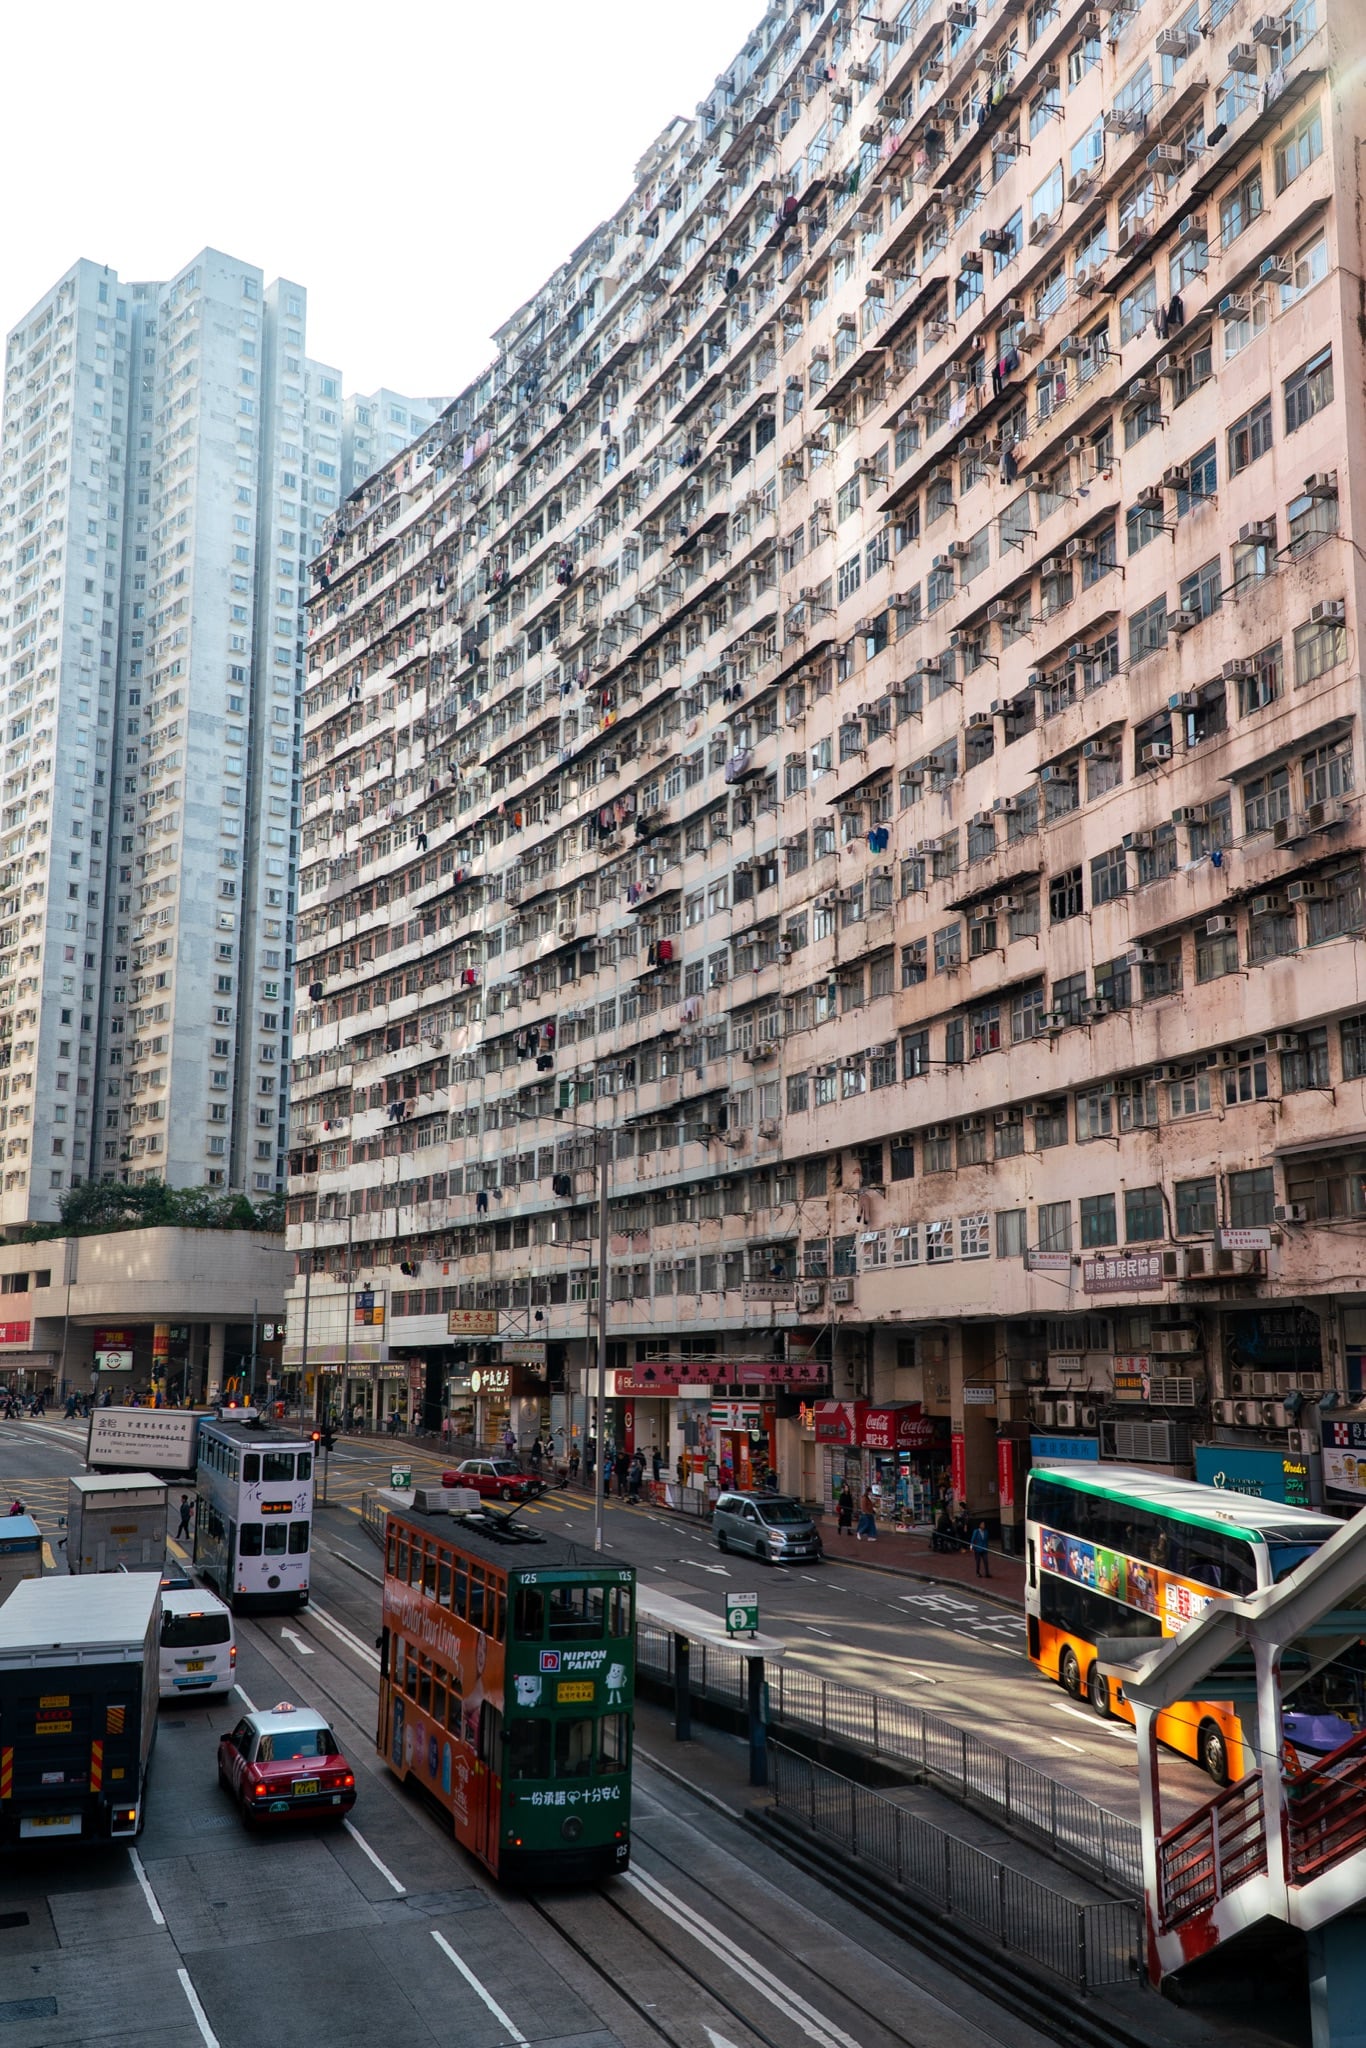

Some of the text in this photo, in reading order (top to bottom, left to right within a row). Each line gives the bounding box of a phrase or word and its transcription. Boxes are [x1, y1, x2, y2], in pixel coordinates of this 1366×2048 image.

[1085, 1258, 1160, 1281] 鰂魚涌居民協會
[452, 1312, 495, 1323] 大發文具
[663, 1366, 727, 1378] 新華地產
[866, 1414, 889, 1430] Coca-Cola
[1286, 1479, 1304, 1491] SPA
[521, 1574, 537, 1584] 125
[619, 1572, 632, 1581] 125
[401, 1593, 422, 1635] Color
[422, 1606, 438, 1648] Your
[437, 1616, 461, 1671] Living
[562, 1650, 607, 1661] NIPPON
[567, 1660, 603, 1670] PAINT
[520, 1785, 620, 1806] 一份承諾 十分安心
[617, 1844, 628, 1857] 125
